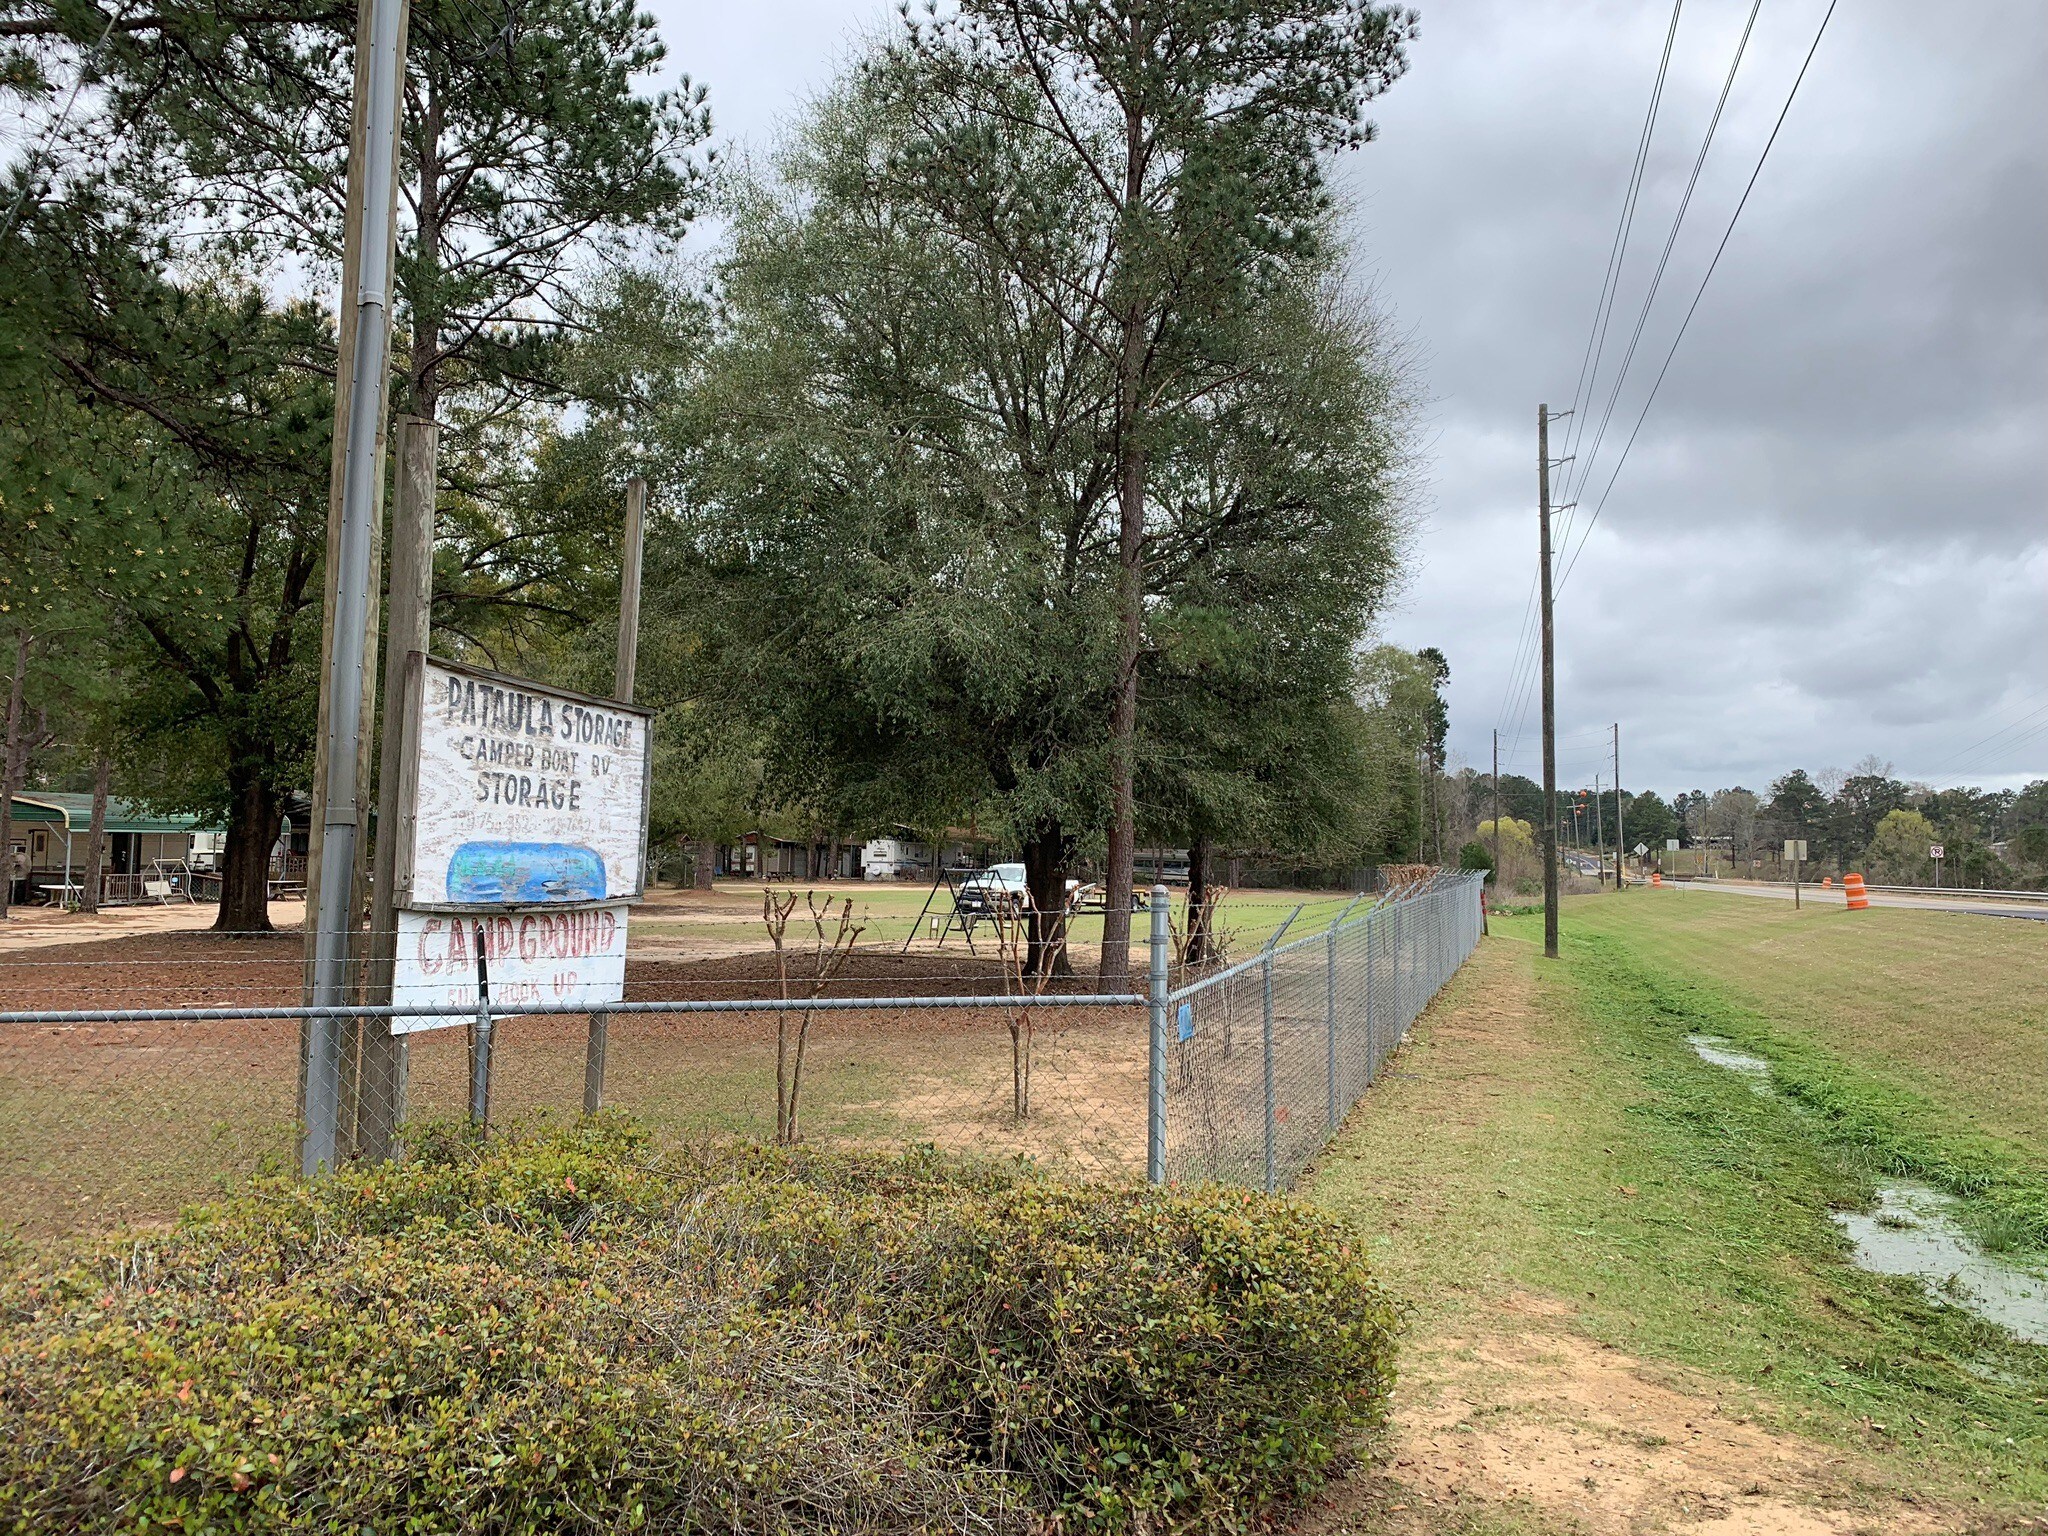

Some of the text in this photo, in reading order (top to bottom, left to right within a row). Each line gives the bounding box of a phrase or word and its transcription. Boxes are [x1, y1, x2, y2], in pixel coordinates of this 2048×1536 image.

[447, 676, 632, 749] PATAULA STORAGE
[460, 735, 611, 776] CAMPER BOAT RV
[475, 771, 581, 811] STORAGE
[417, 910, 616, 976] CAMPGROUND
[499, 978, 541, 1003] HOOK
[553, 971, 578, 997] UP
